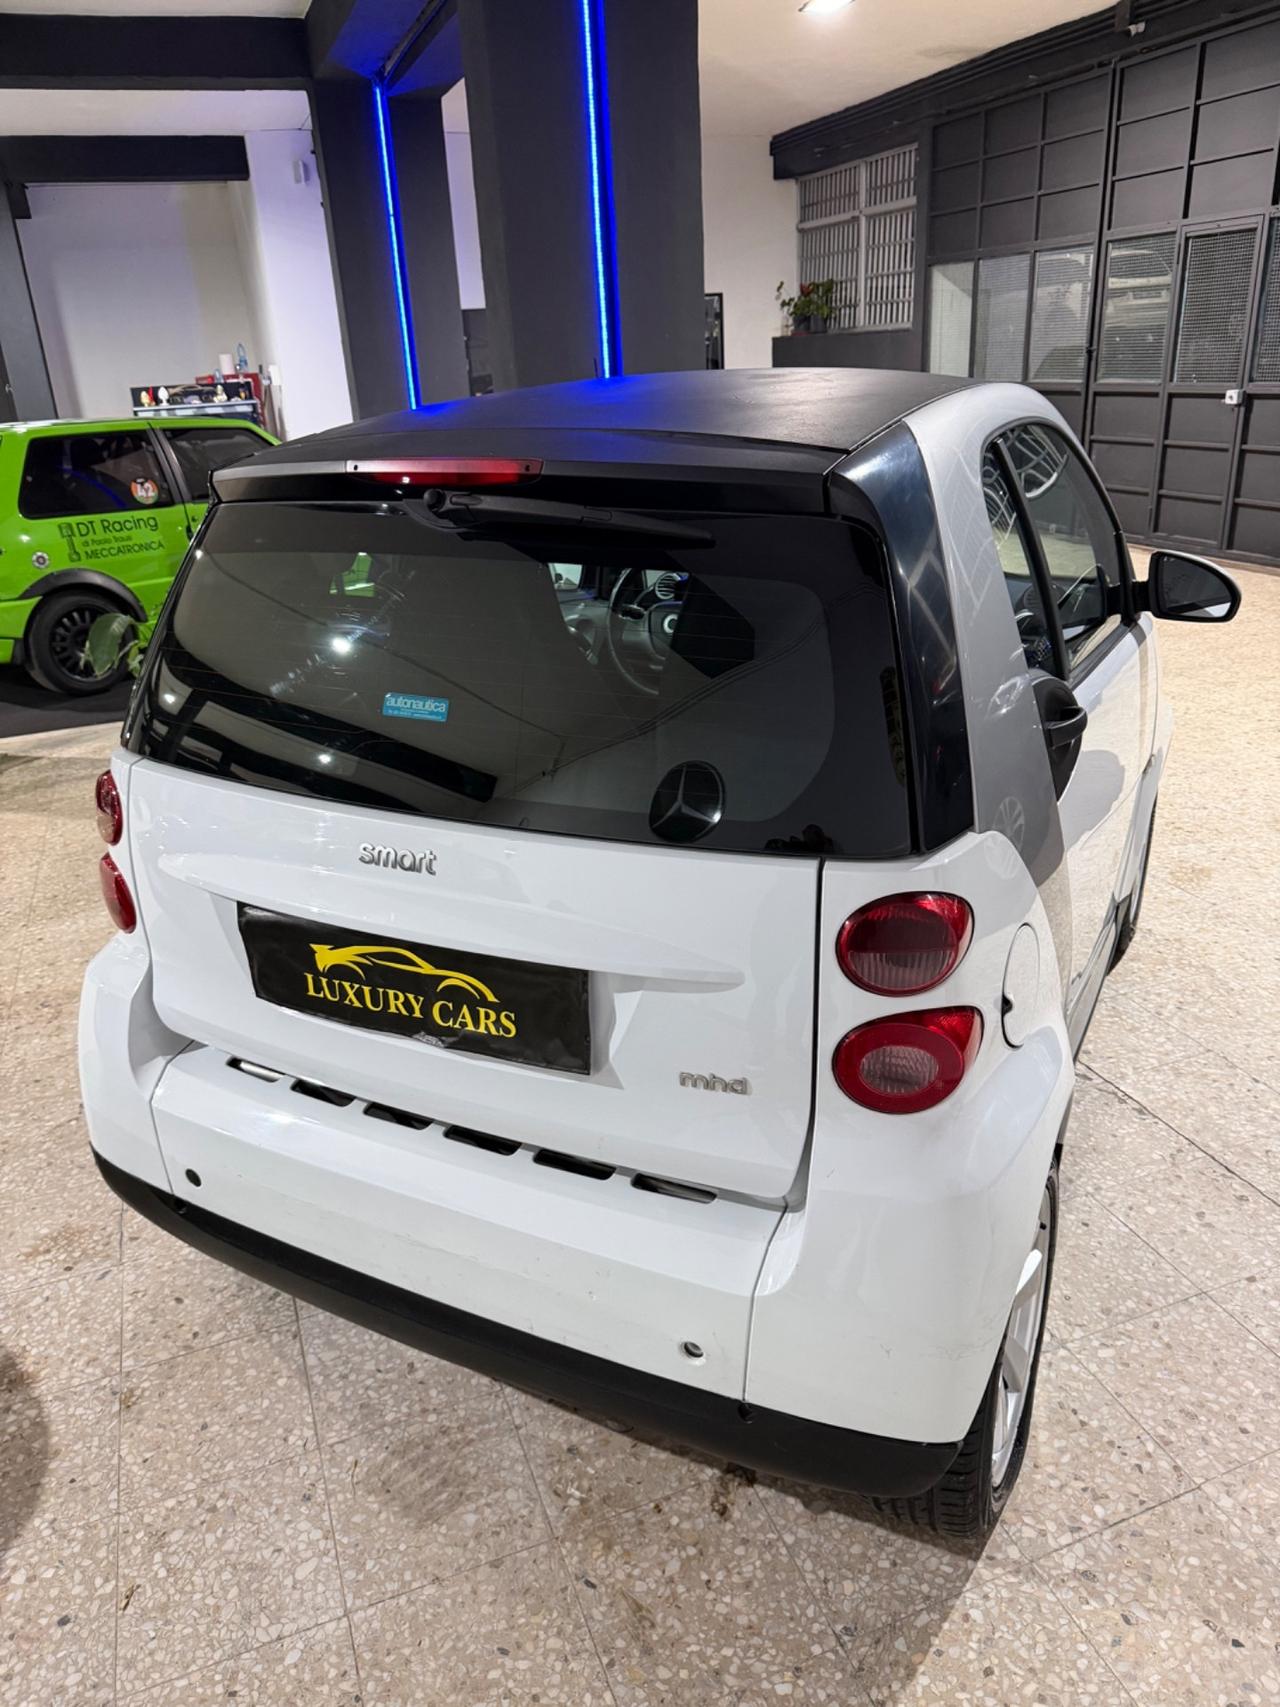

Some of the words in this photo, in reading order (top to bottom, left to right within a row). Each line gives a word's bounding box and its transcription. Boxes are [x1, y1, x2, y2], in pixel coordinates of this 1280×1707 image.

[77, 521, 97, 537] DT
[101, 515, 159, 533] Racing
[84, 540, 166, 560] MECCATRONICA
[386, 695, 447, 713] autonautica
[358, 842, 438, 876] smart
[304, 972, 425, 1020] LUXURY
[432, 1000, 517, 1039] CARS
[679, 1071, 752, 1097] mhd
